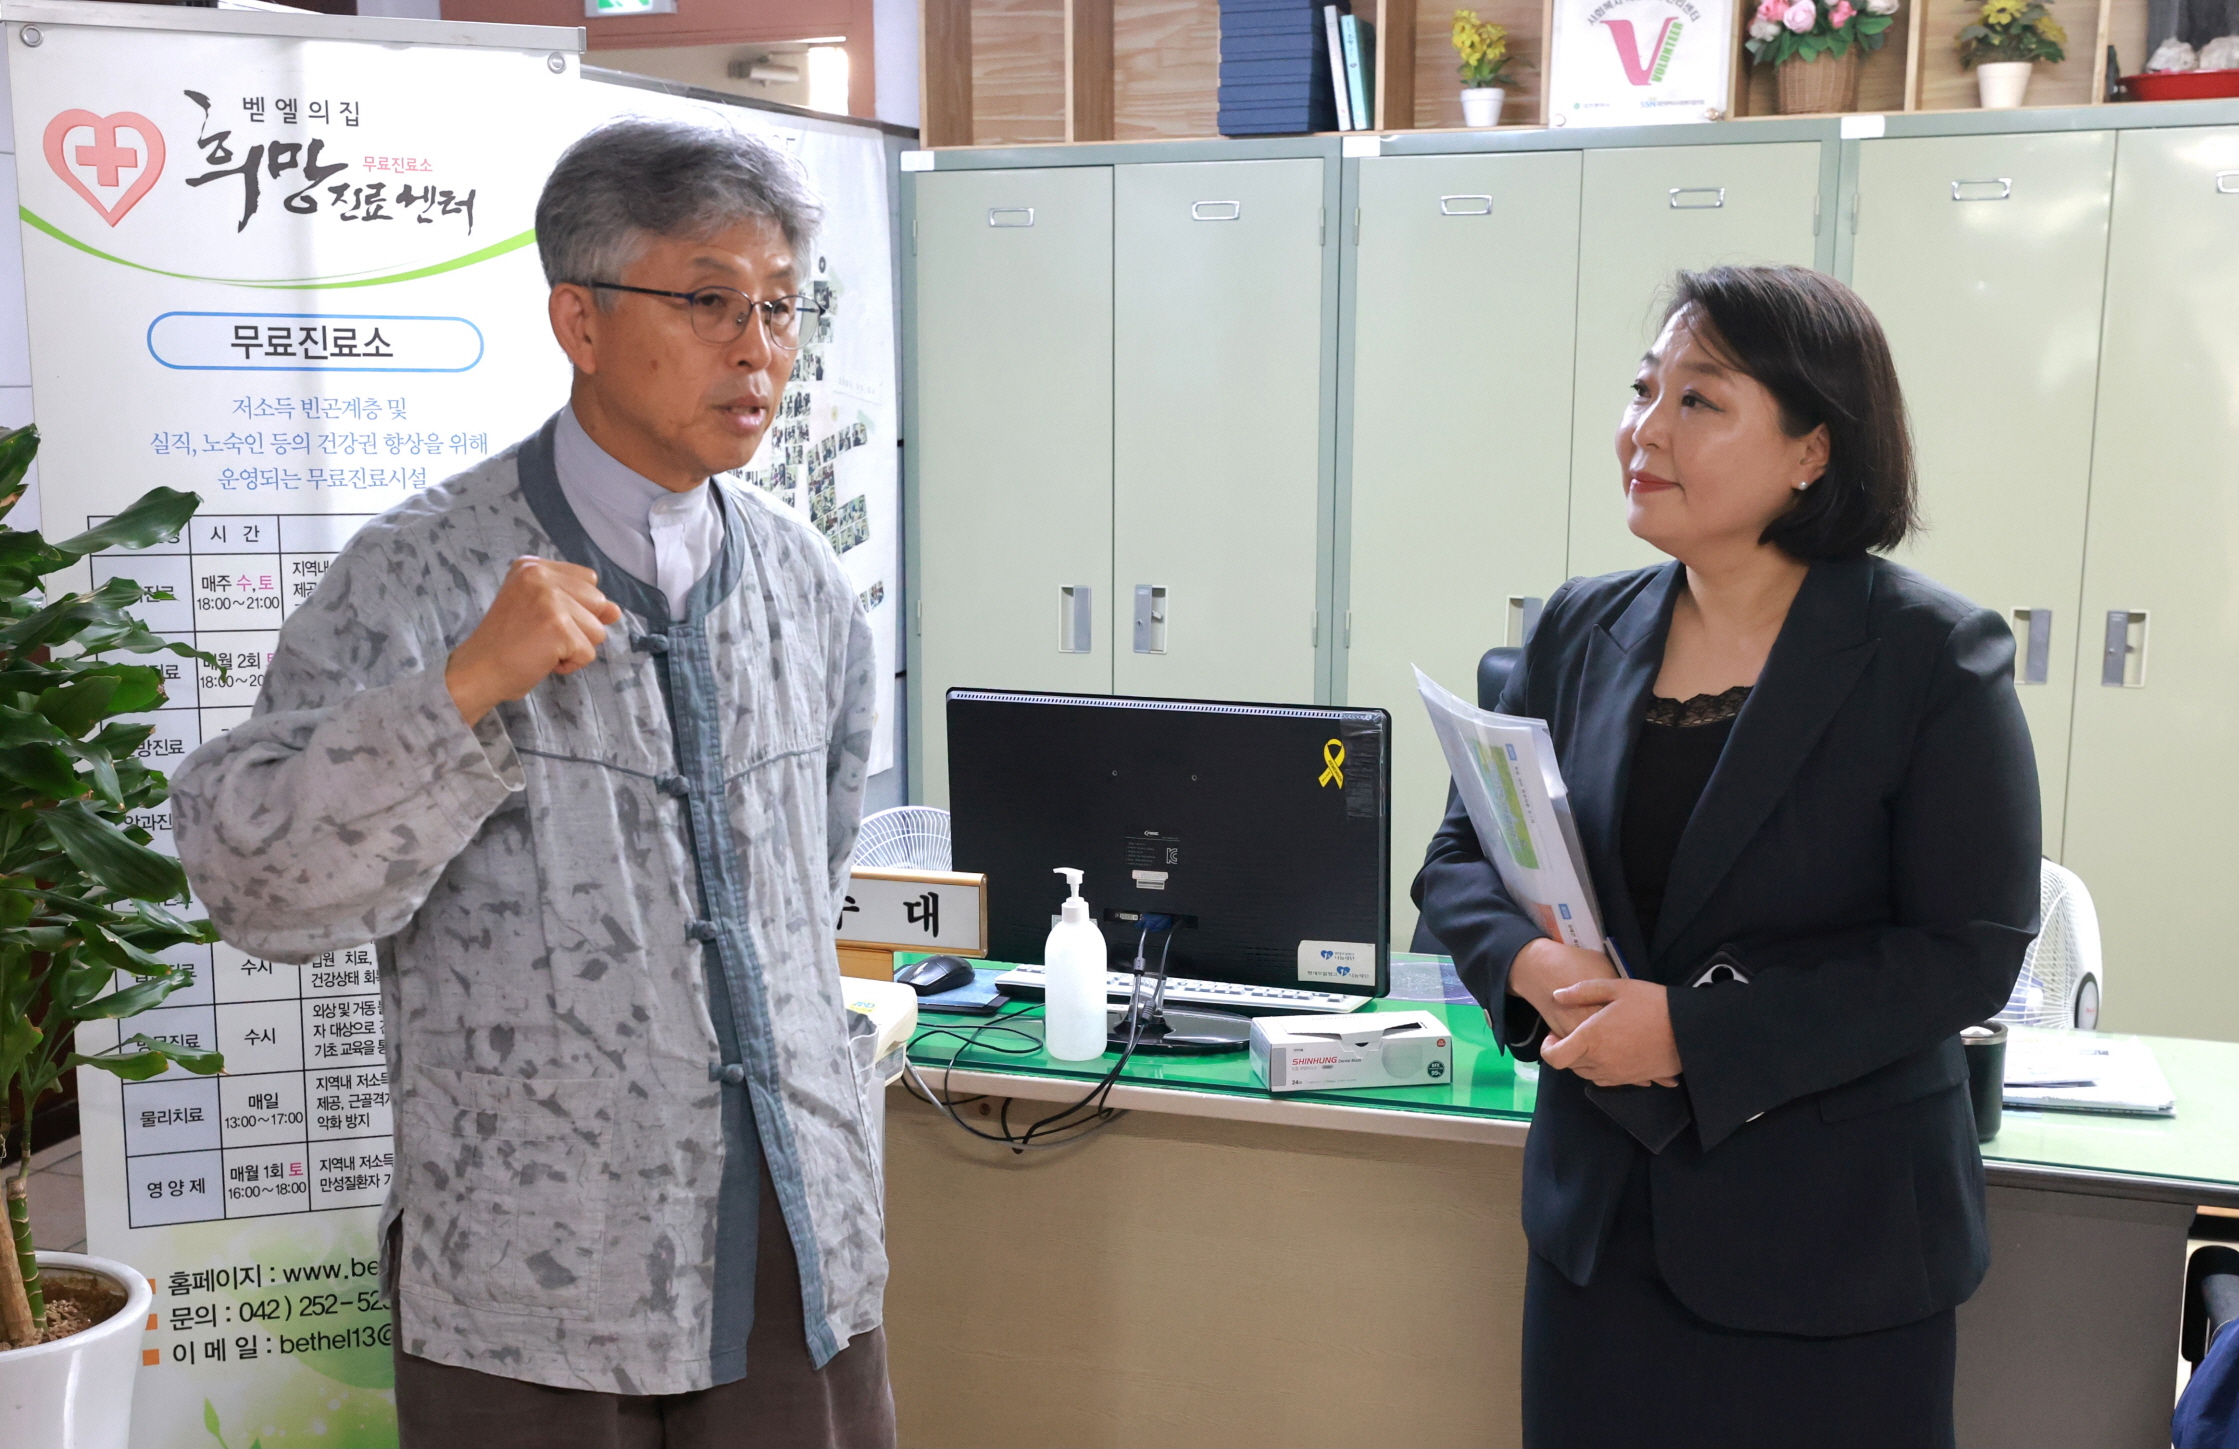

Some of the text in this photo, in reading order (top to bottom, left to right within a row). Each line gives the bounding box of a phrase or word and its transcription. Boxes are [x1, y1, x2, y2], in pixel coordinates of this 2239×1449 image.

[1651, 21, 1683, 82] VOLUNTEER
[184, 90, 348, 233] 희망
[362, 155, 433, 174] 무료진료소
[328, 182, 477, 237] 진료 센터
[230, 325, 394, 360] 무료진료소
[232, 395, 407, 421] 저소득 빈곤계층 및
[150, 431, 488, 458] 실직, 노숙인 등의 건강권 향상을 위해
[217, 466, 430, 492] 운영되는 무료진료시설
[292, 560, 330, 577] 지역내
[201, 574, 232, 593] 매주
[196, 597, 280, 610] 18:00~21:00
[236, 652, 262, 670] 2회
[239, 957, 274, 977] 수시
[344, 950, 374, 967] 치료,
[311, 968, 360, 989] 건강상태
[312, 1002, 337, 1020] 외상
[338, 1001, 351, 1019] 및
[352, 1000, 377, 1018] 거동
[243, 1026, 277, 1047] 수시
[313, 1022, 327, 1040] 자
[329, 1020, 377, 1039] 대상으로
[314, 1041, 339, 1060] 기초
[339, 1038, 376, 1058] 교육을
[1292, 1056, 1338, 1066] SHINHUNG
[315, 1073, 354, 1093] 지역내
[248, 1092, 279, 1111] 매일
[315, 1094, 345, 1112] 제공,
[140, 1107, 205, 1128] 물리치료
[224, 1112, 303, 1129] 13:00~17:00
[316, 1111, 371, 1132] 악화 방지
[230, 1159, 305, 1181] 매월 1회 토
[319, 1152, 395, 1174] 지역내 저소득
[227, 1182, 307, 1199] 16:00~18:00
[319, 1171, 381, 1194] 만성질환자
[168, 1265, 262, 1296] 홈페이지
[169, 1303, 217, 1332] 문의
